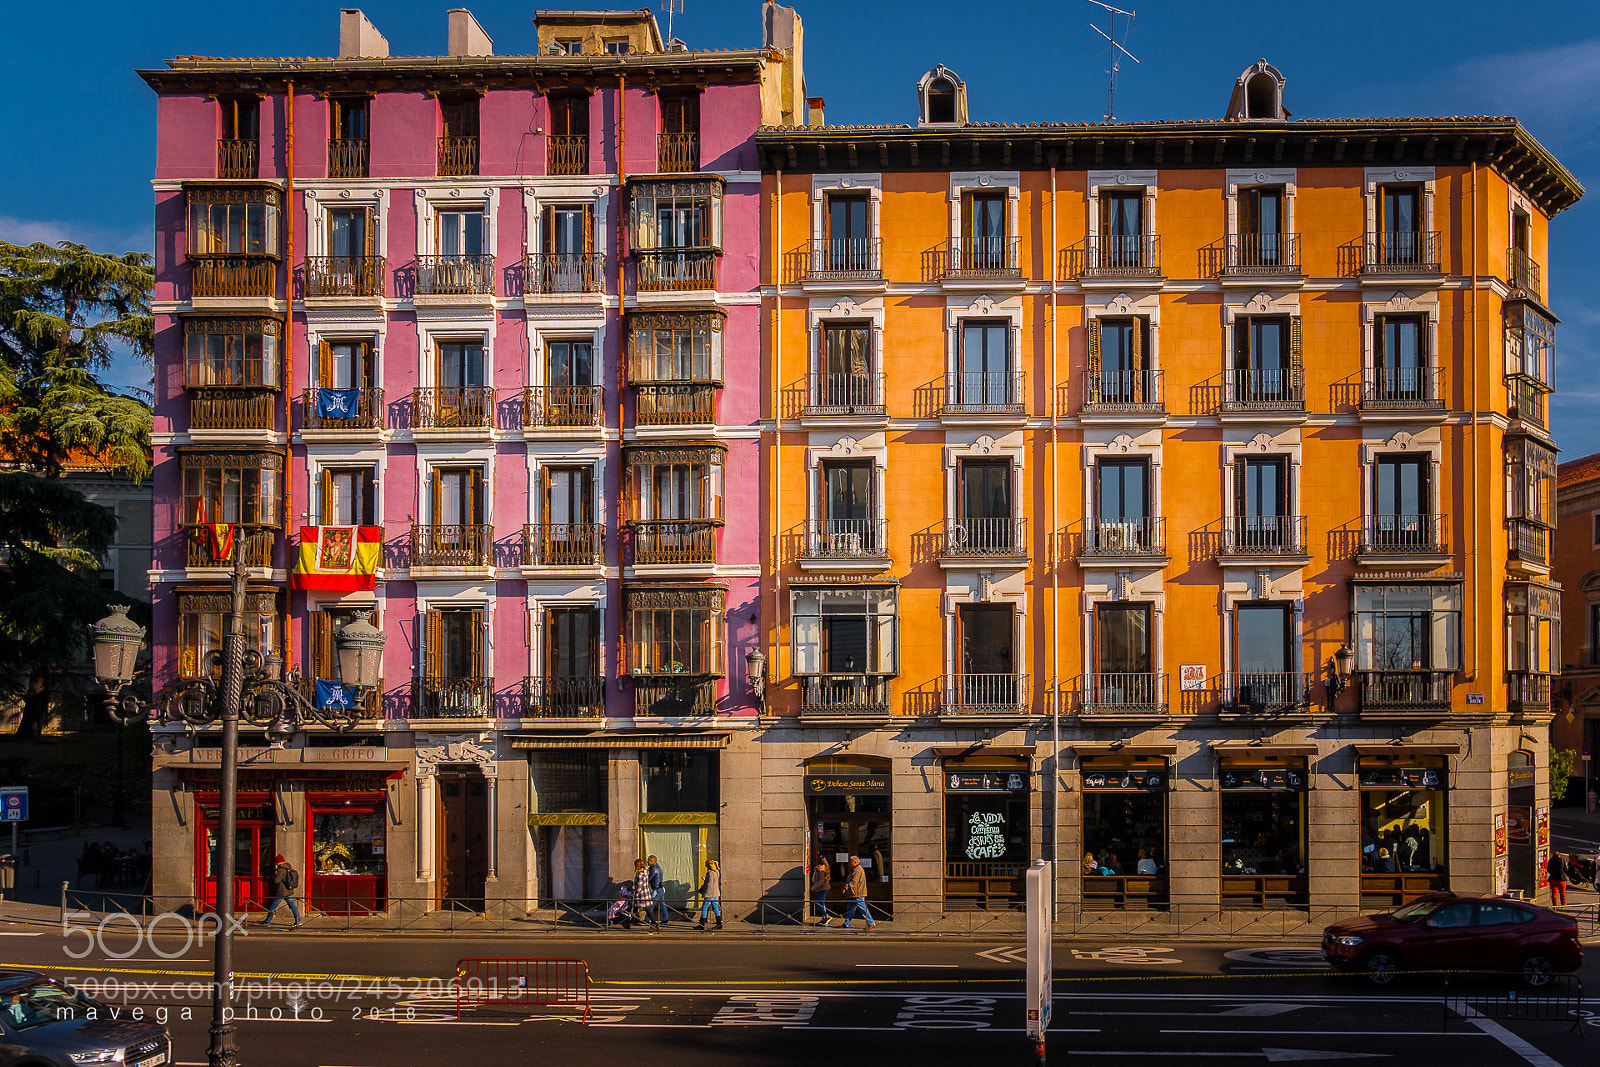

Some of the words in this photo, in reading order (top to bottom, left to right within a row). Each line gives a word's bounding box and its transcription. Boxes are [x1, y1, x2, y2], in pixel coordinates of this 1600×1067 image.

[197, 749, 273, 760] VEROUTH
[332, 748, 374, 760] GRIFO
[848, 780, 866, 788] Santa
[529, 813, 558, 825] POR
[981, 812, 1006, 824] VIDA
[973, 844, 998, 859] CAFÉ
[893, 997, 998, 1029] SOLO
